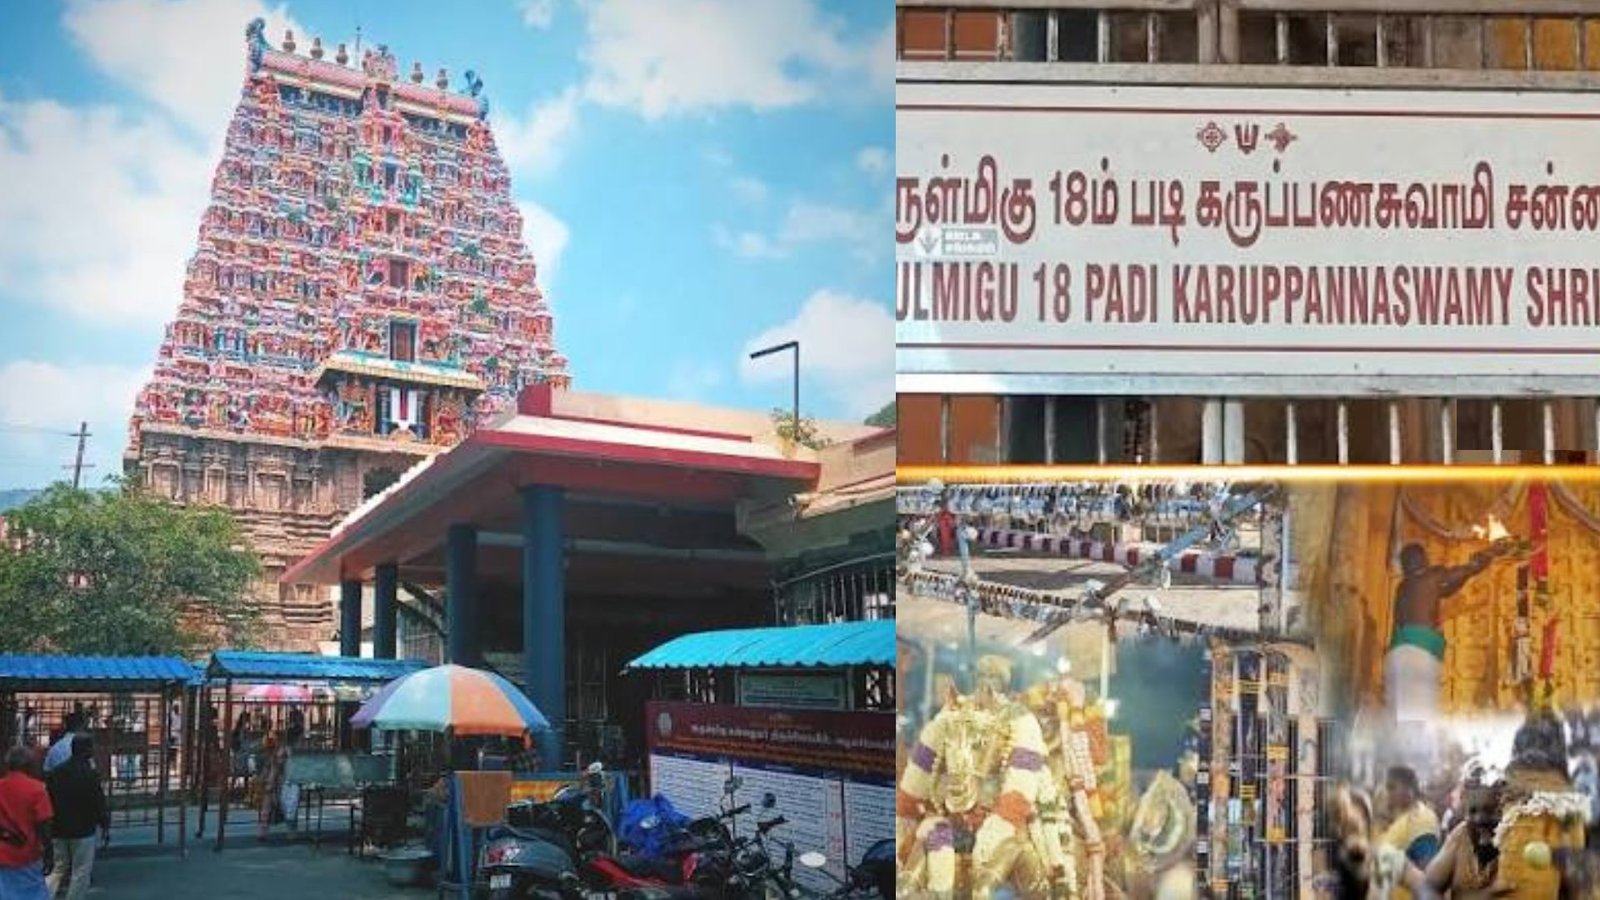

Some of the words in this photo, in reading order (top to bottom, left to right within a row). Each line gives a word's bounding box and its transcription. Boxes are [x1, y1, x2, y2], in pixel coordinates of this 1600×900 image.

[1049, 157, 1119, 226] 18ம்
[1131, 179, 1187, 247] படி
[1196, 158, 1495, 248] கருப்பணசுவாமி
[1033, 263, 1071, 323] 18
[1085, 263, 1157, 323] PADI
[1172, 263, 1514, 326] KARUPPANNASWAMY
